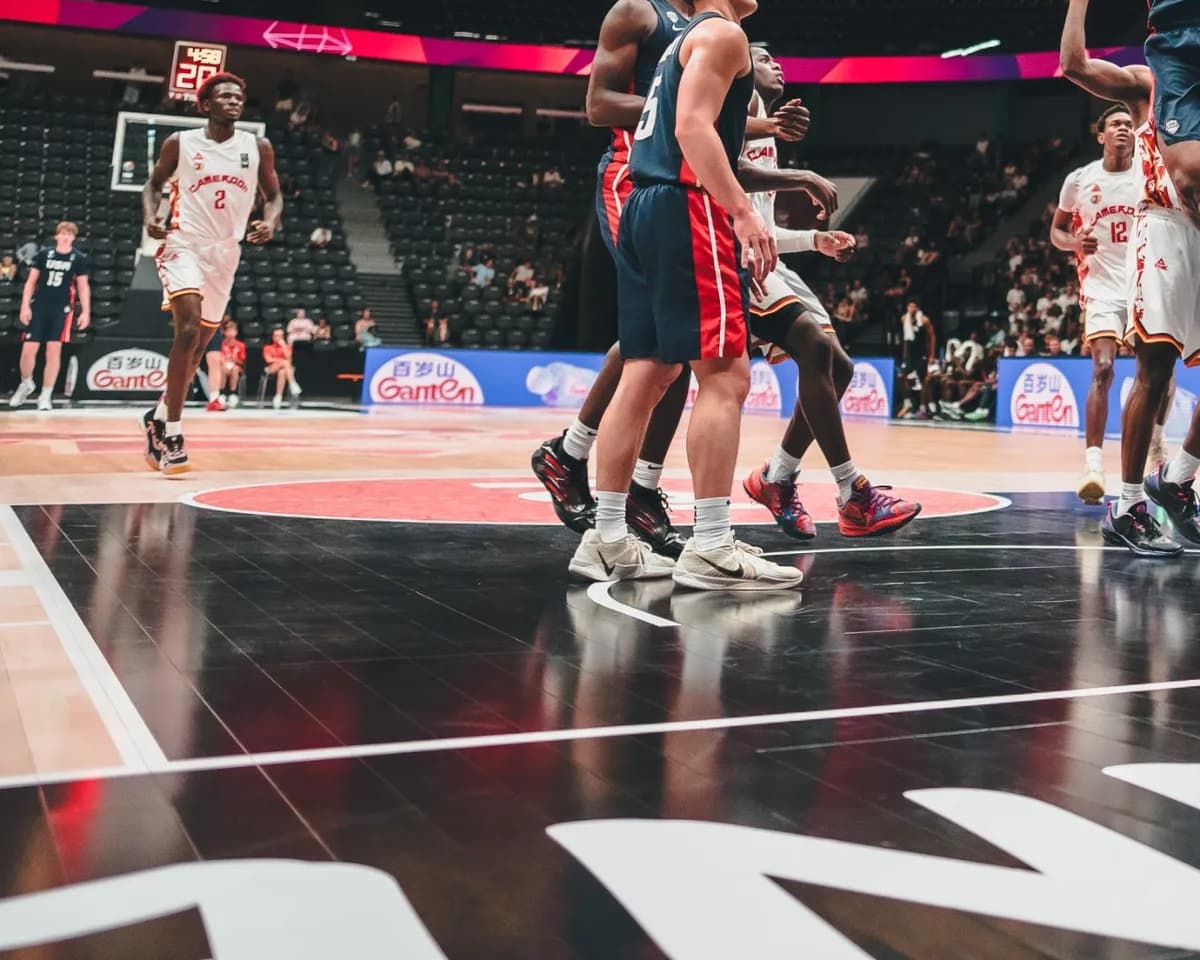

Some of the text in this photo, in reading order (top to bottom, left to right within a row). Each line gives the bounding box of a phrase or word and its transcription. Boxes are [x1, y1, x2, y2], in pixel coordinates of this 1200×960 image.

[214, 189, 226, 209] 2
[1111, 221, 1128, 243] 12
[46, 271, 64, 287] 15
[393, 360, 456, 377] 百岁山
[94, 369, 167, 389] Gante
[1024, 373, 1061, 393] 百岁山
